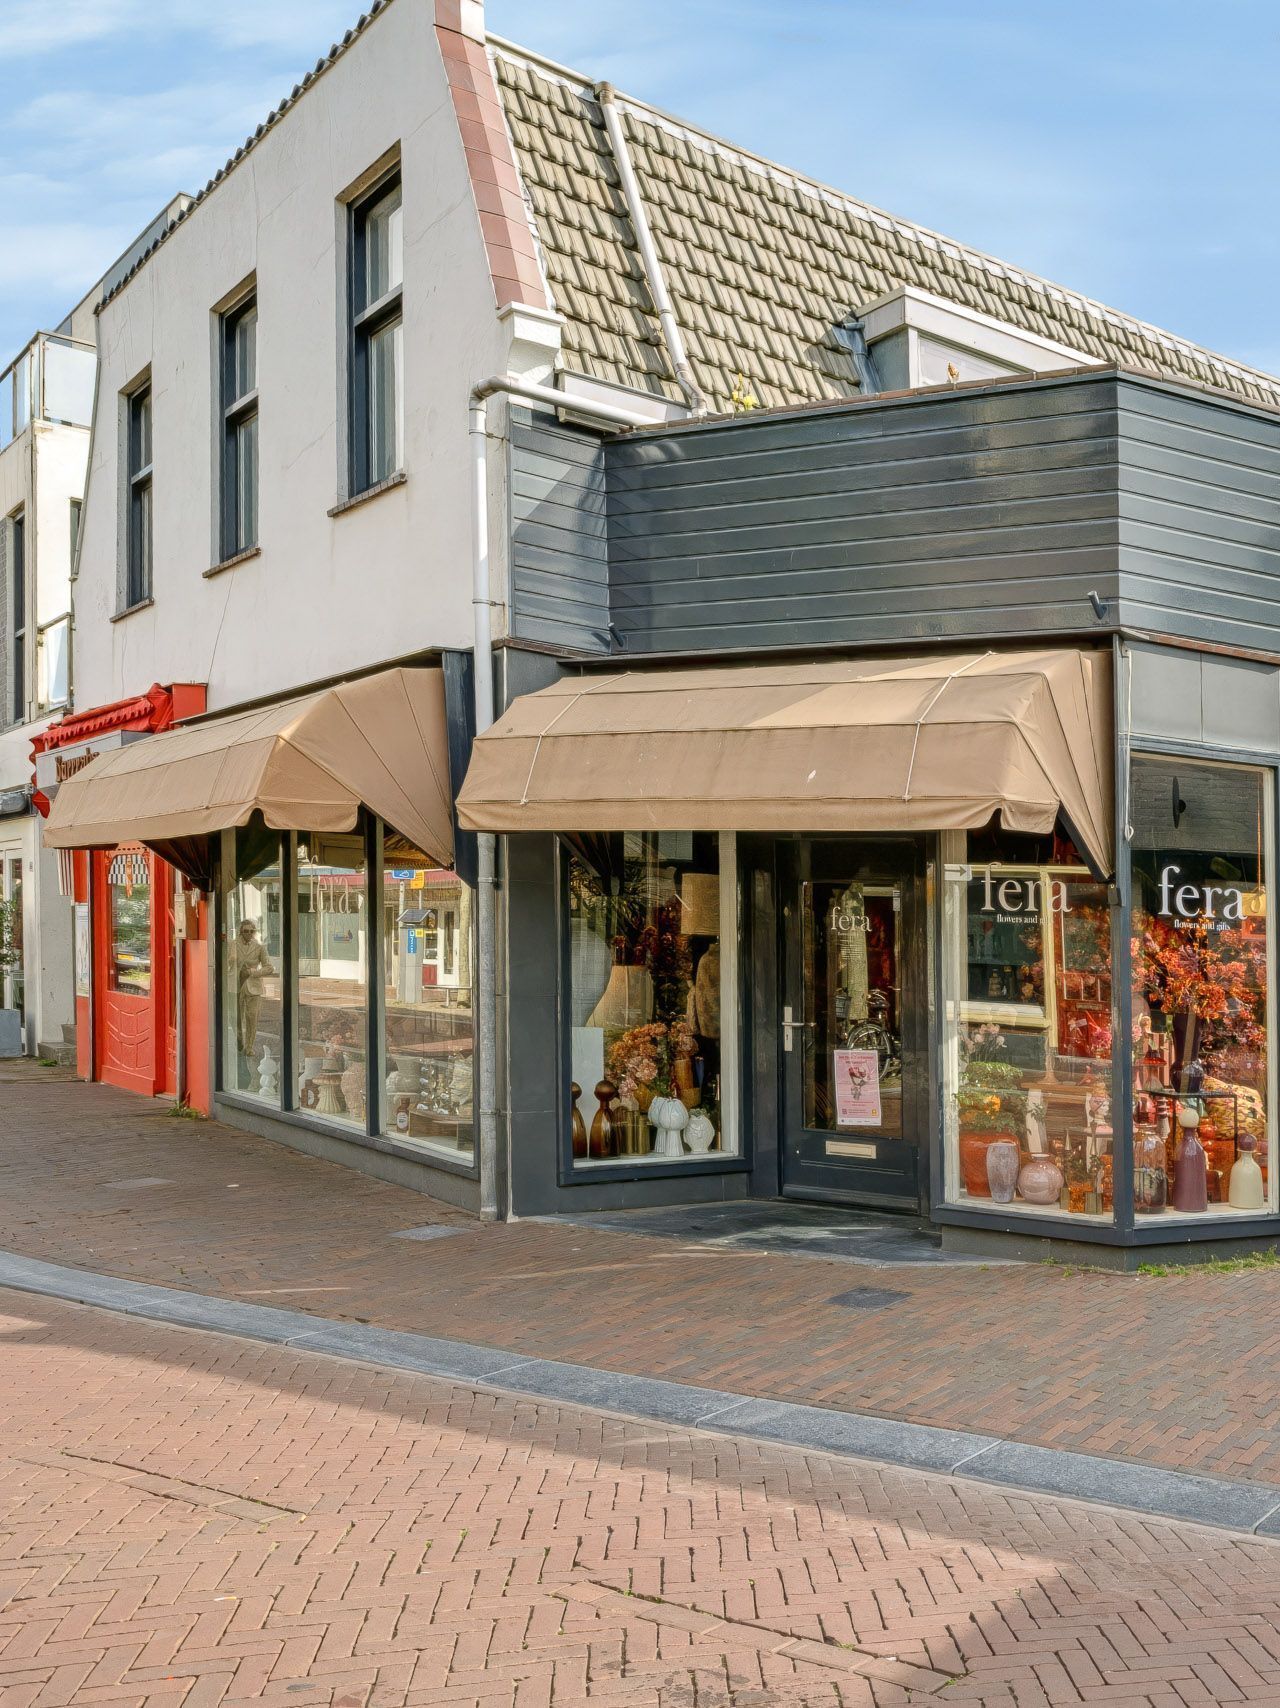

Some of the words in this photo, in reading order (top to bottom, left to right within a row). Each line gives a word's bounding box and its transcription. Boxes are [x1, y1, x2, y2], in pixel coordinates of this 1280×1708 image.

[980, 861, 1073, 913] fera
[1157, 865, 1249, 920] fera
[830, 906, 873, 932] fera
[996, 913, 1023, 924] flowers
[1023, 915, 1038, 924] and
[1174, 918, 1200, 929] flowers
[1201, 921, 1215, 930] and
[1216, 924, 1231, 932] gifts
